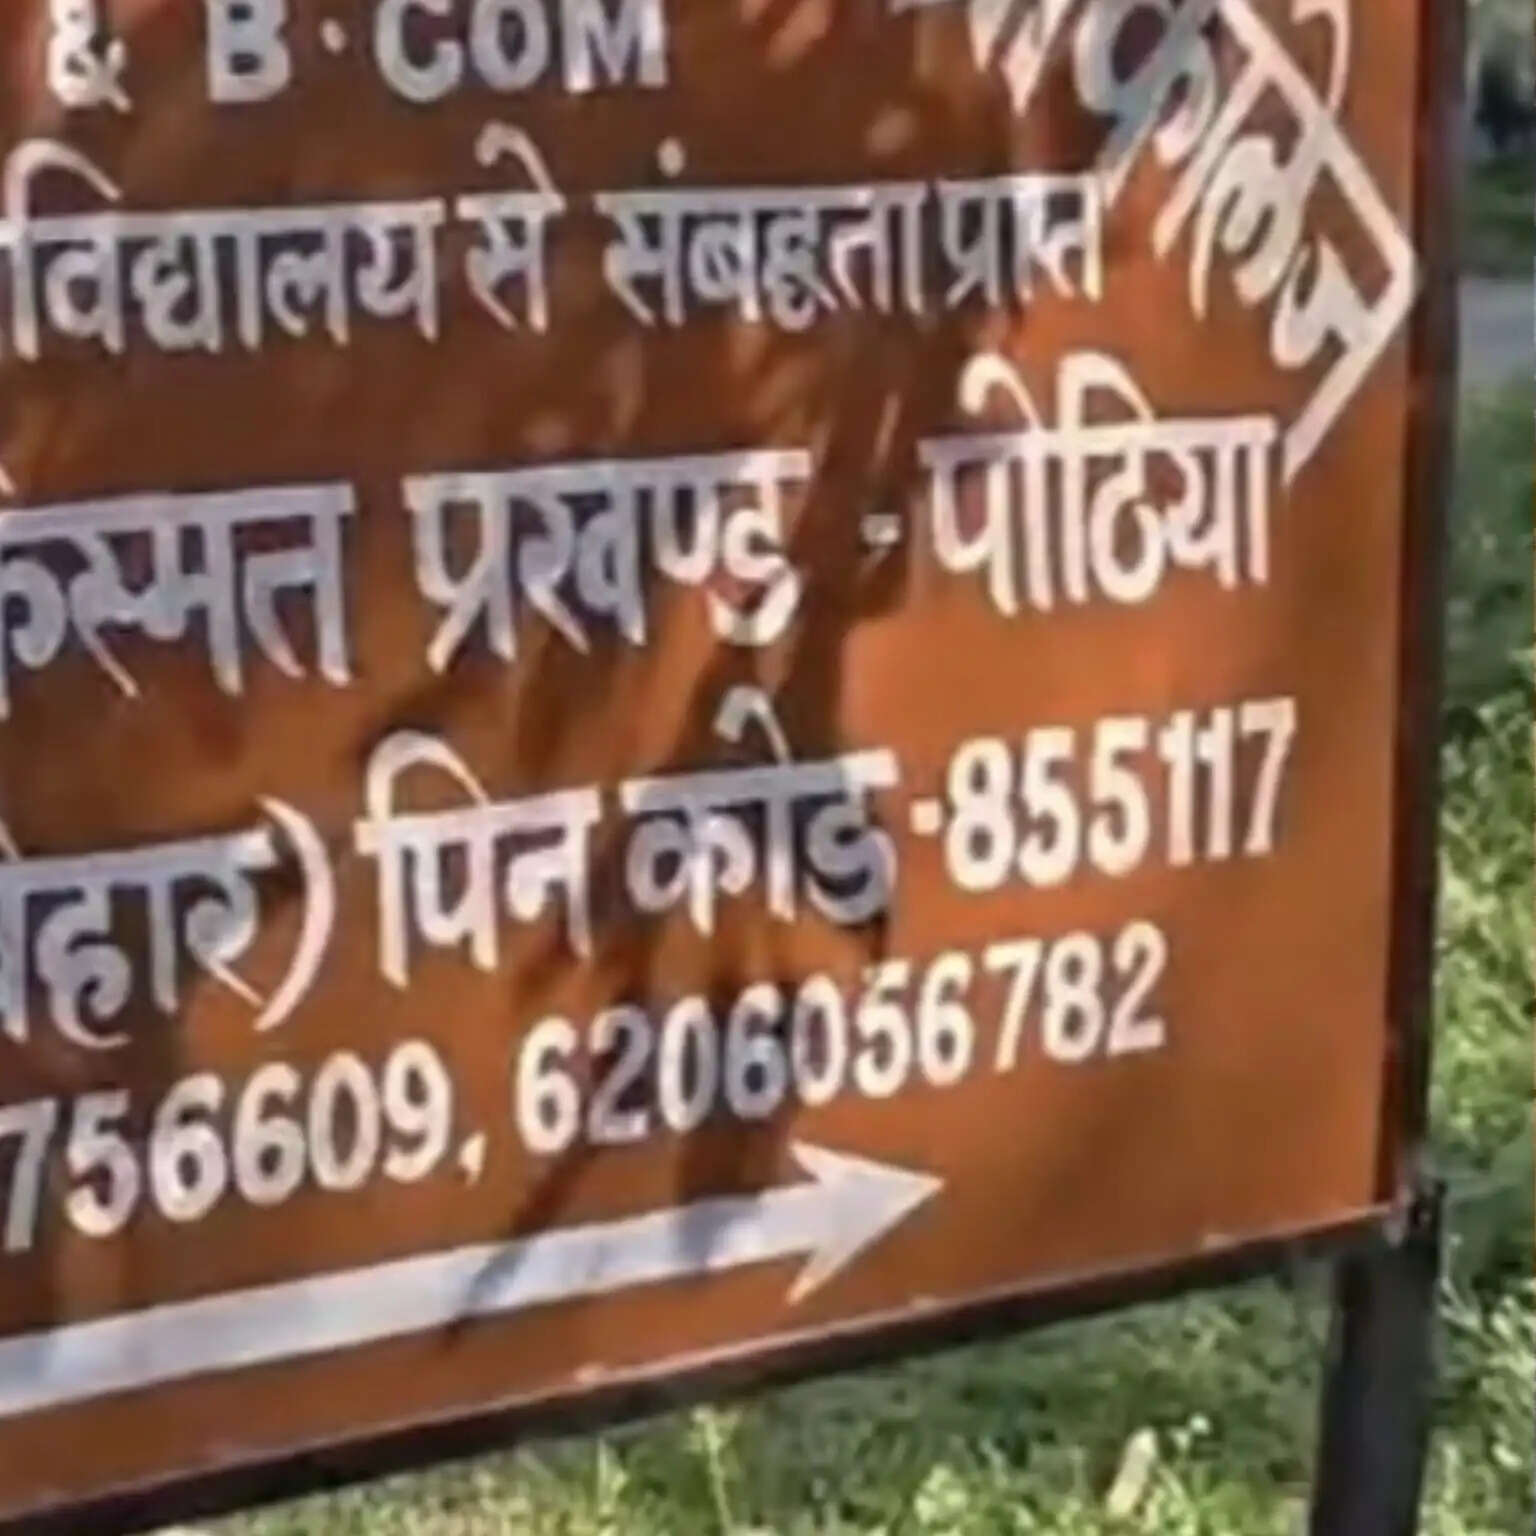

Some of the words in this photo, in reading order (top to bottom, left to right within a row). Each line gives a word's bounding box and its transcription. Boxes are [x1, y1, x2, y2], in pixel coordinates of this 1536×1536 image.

[456, 122, 562, 331] से
[405, 449, 813, 673] प्रखण्ड
[357, 728, 600, 990] पिन
[516, 921, 1170, 1156] 6206056782
